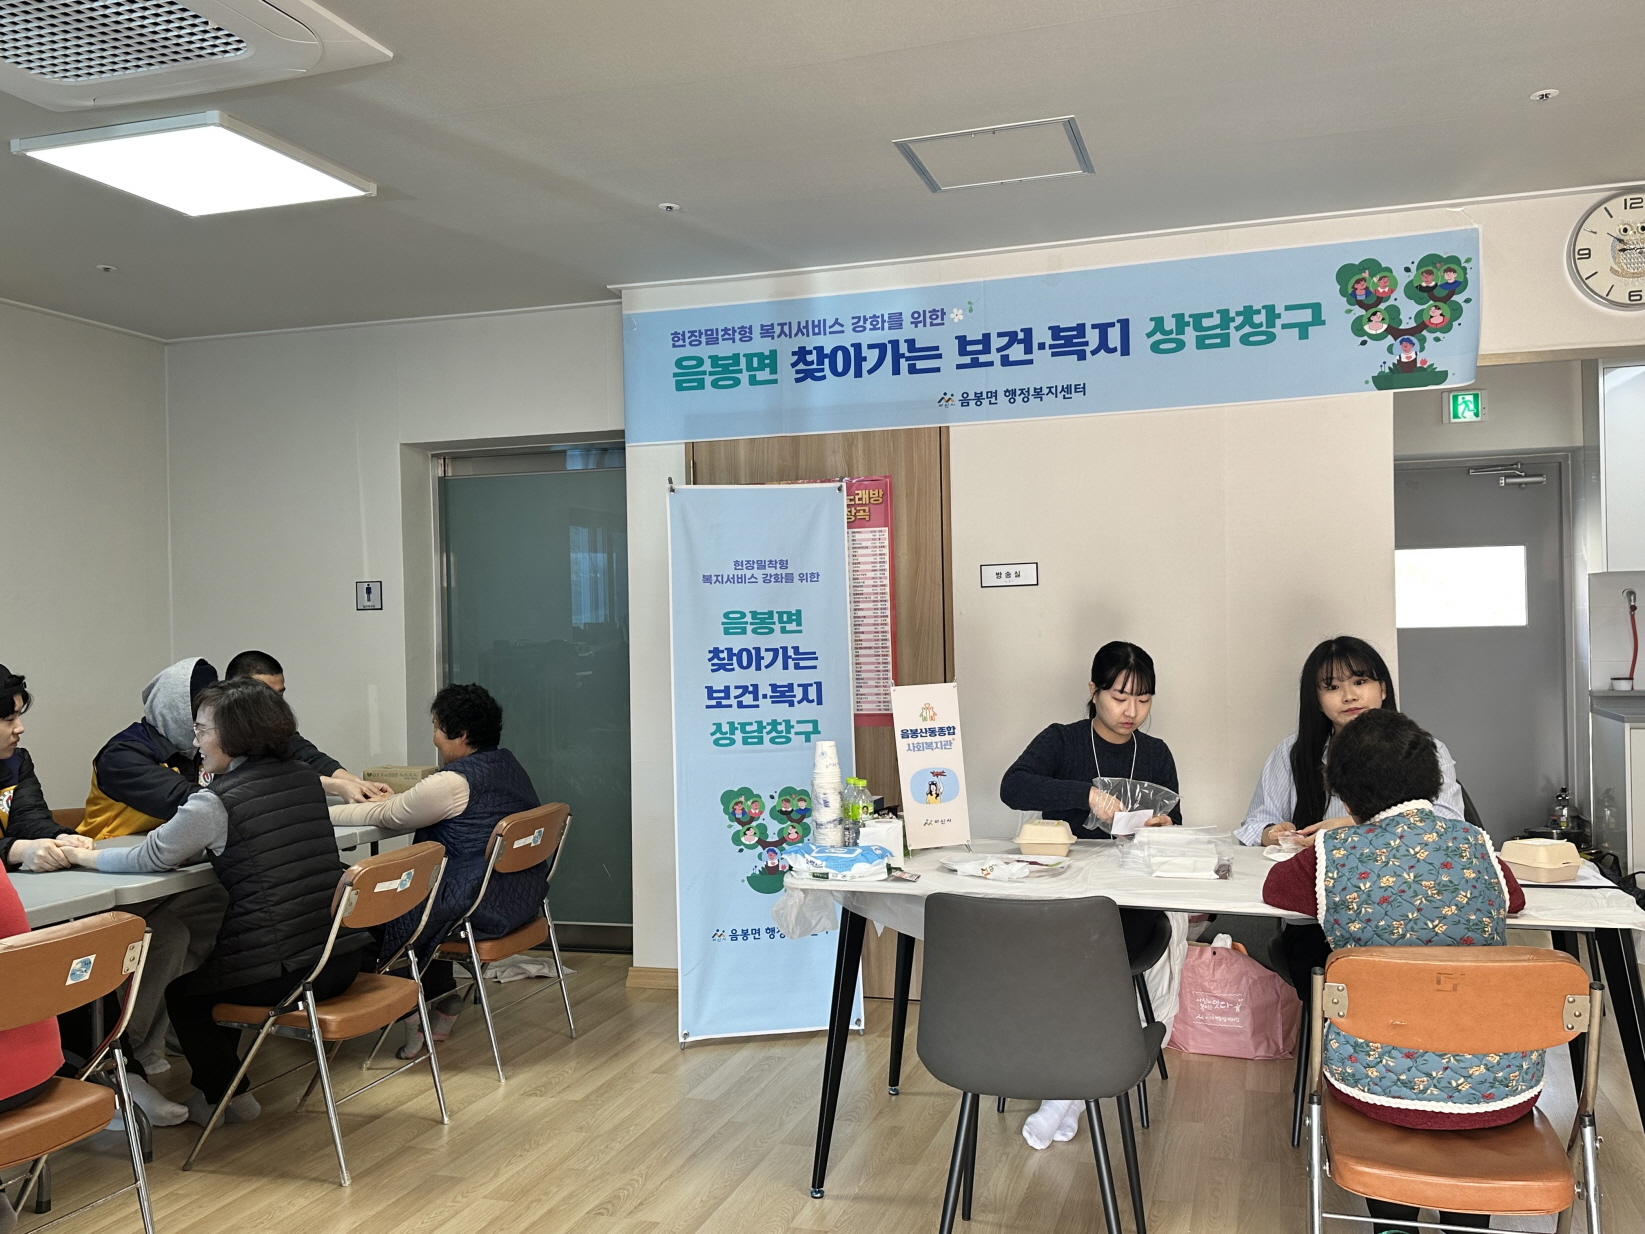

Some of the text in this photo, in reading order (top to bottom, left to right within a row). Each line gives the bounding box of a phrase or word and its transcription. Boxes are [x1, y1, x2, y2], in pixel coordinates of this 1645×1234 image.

[1623, 196, 1644, 211] 12
[1576, 247, 1592, 261] 9
[1627, 289, 1643, 303] 6
[670, 307, 947, 349] 현장밀착형 복지서비스 강화를 위한
[672, 301, 1327, 392] 음봉면 찾아가는 보건·복지 상담창구
[958, 382, 1087, 408] 음봉면 행정복지센터
[733, 558, 790, 571] 현장밀착형
[702, 571, 821, 585] 복지서비스 강화를 위한
[721, 608, 803, 636] 음봉면
[707, 645, 819, 673] 찾아가는
[704, 681, 823, 709] 보건·복지
[709, 718, 822, 748] 상담창구
[900, 725, 956, 740] 음봉산동종합
[906, 739, 953, 752] 사회복지관
[728, 927, 762, 942] 음봉면
